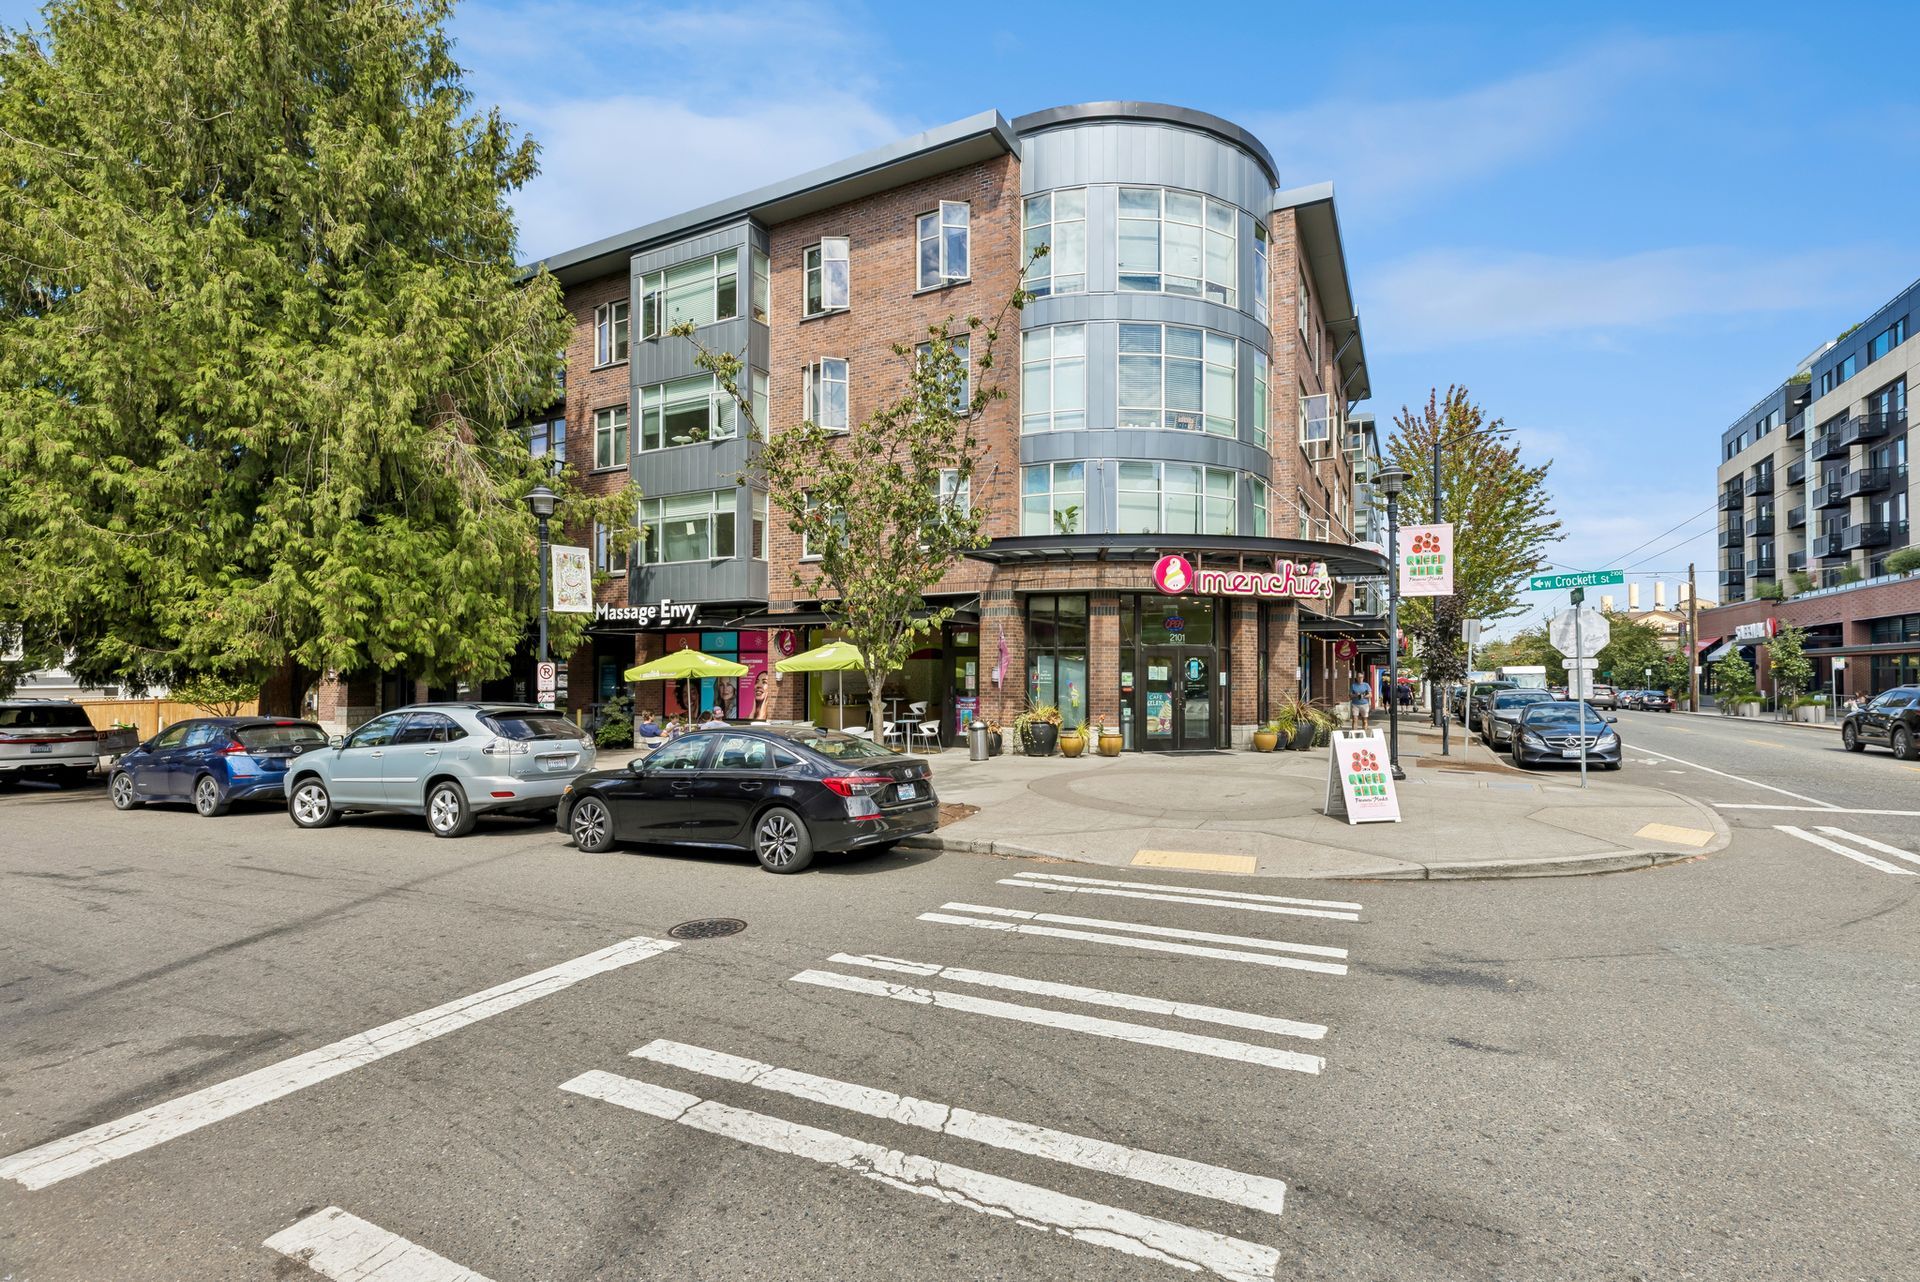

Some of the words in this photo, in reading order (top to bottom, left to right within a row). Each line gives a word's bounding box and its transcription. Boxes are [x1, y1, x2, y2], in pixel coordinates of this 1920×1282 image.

[1202, 560, 1333, 599] menchie's
[1544, 580, 1551, 588] W
[1555, 574, 1596, 587] Crockett
[1600, 575, 1609, 584] St
[595, 602, 656, 626] Massage
[1169, 633, 1186, 642] 2101
